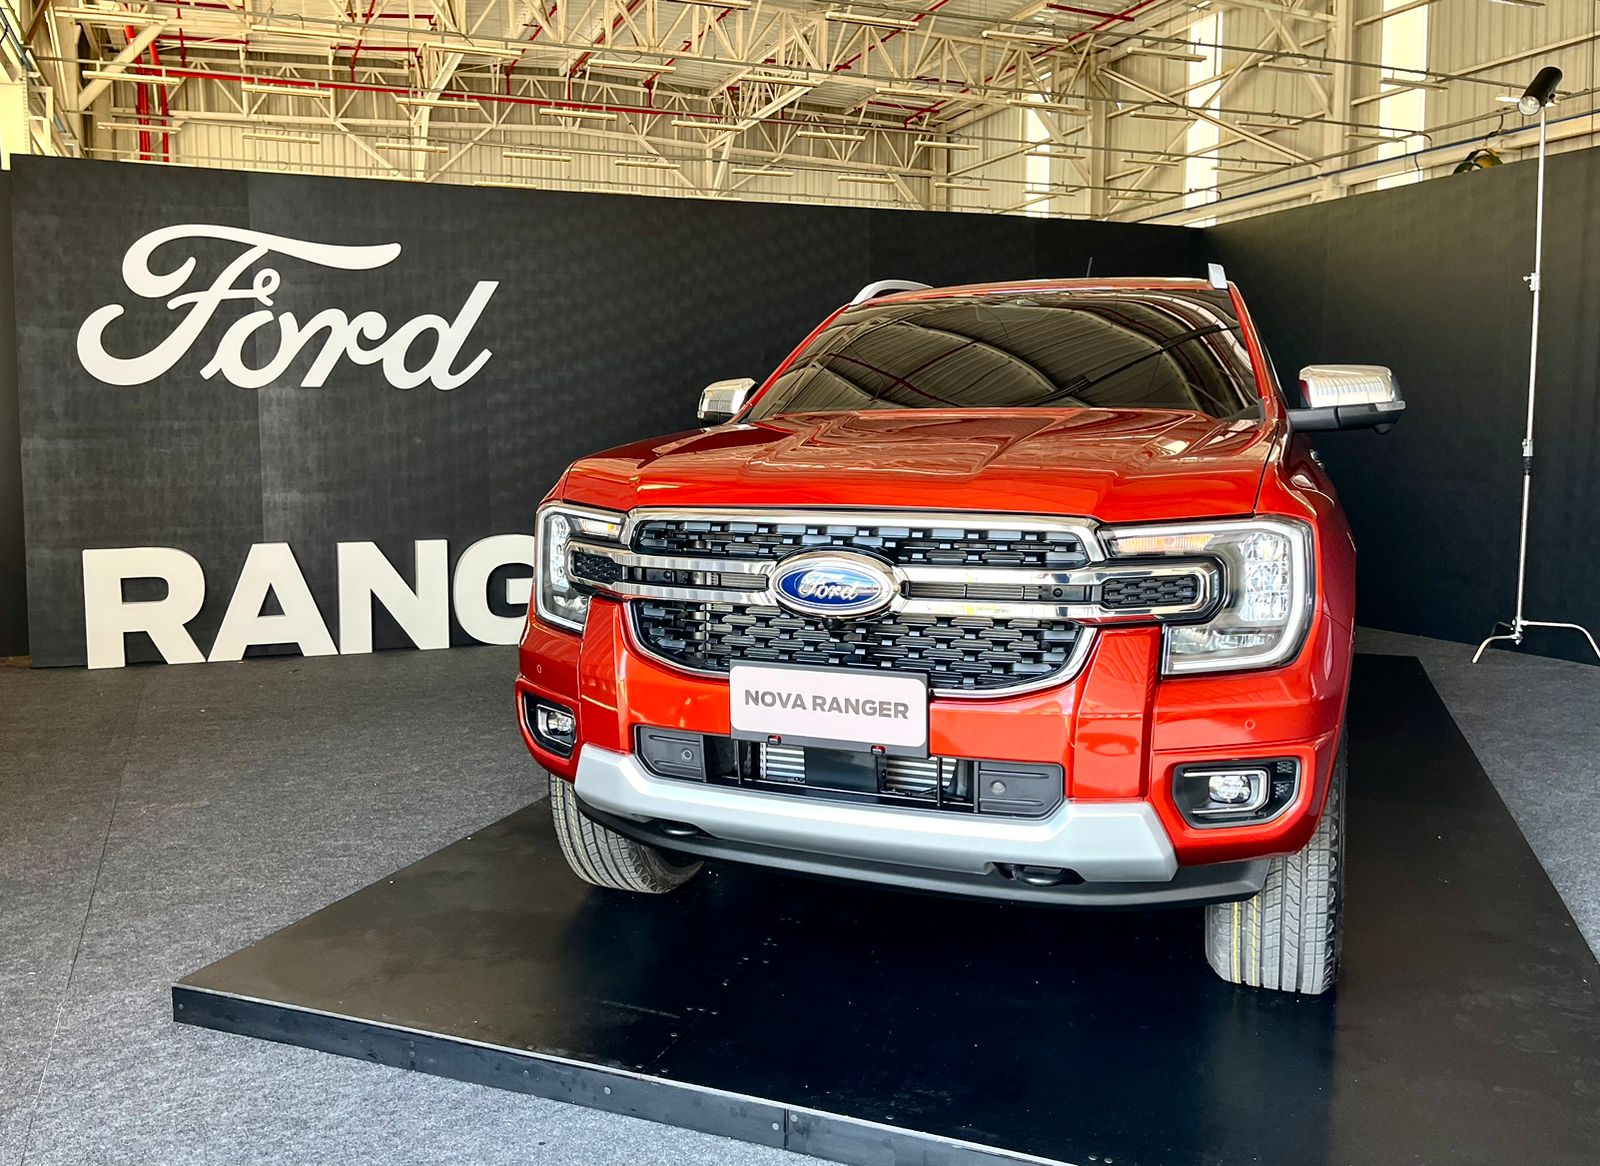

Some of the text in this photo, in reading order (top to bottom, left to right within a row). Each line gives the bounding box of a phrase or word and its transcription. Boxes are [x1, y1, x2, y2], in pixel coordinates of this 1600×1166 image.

[77, 224, 499, 391] Ford
[82, 534, 535, 669] RANG
[798, 568, 859, 600] Ford
[744, 689, 909, 720] NOVA RANGER
